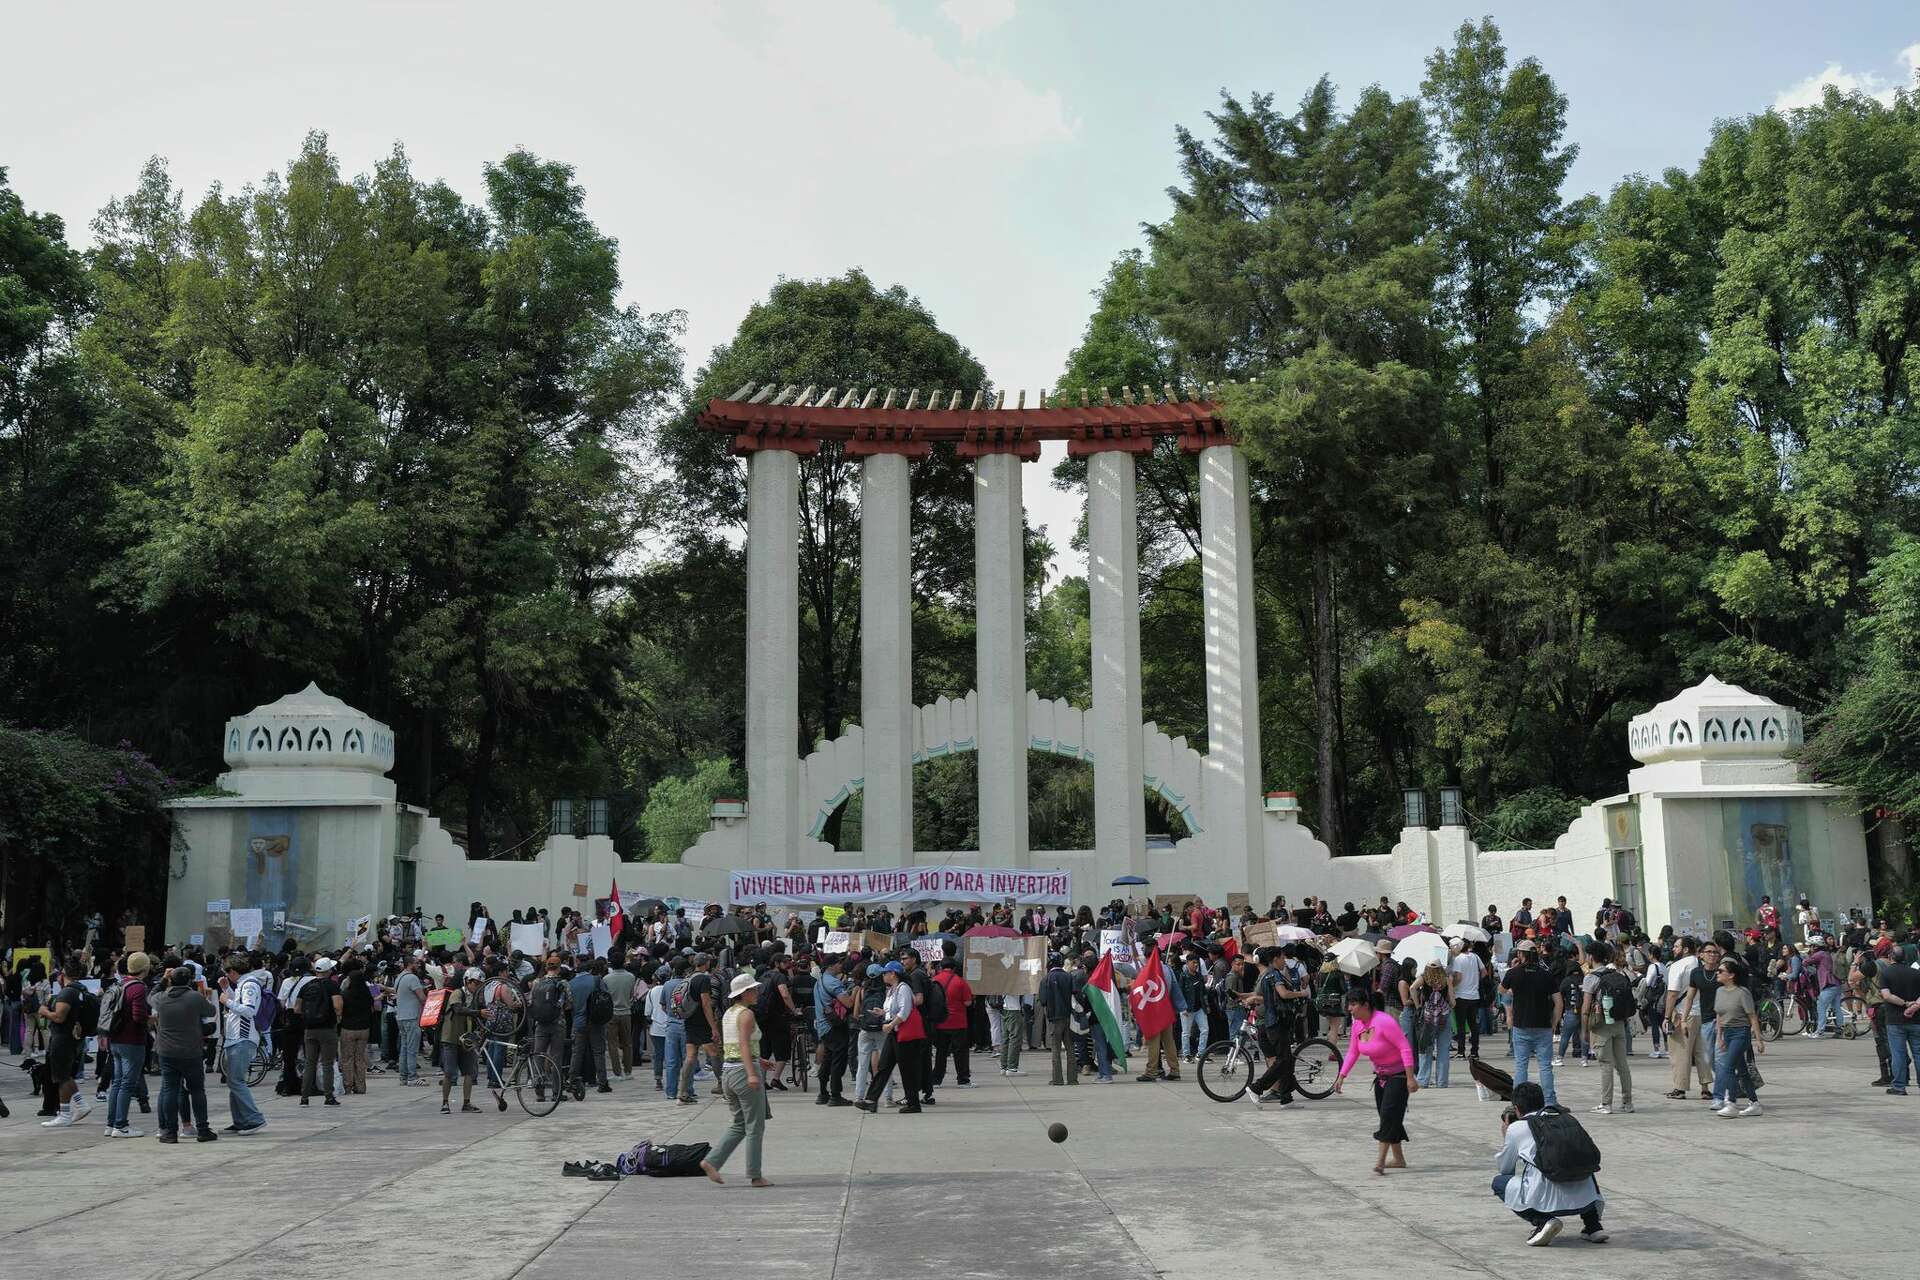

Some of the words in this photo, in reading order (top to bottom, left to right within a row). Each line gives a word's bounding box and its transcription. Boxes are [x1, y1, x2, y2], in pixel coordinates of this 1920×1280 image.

[735, 875, 816, 899] ¡VIVIENDA
[821, 874, 862, 894] PARA
[867, 872, 914, 893] VIVIR,
[919, 872, 939, 891] NO
[944, 872, 984, 892] PARA
[990, 875, 1067, 895] INVERTIR!
